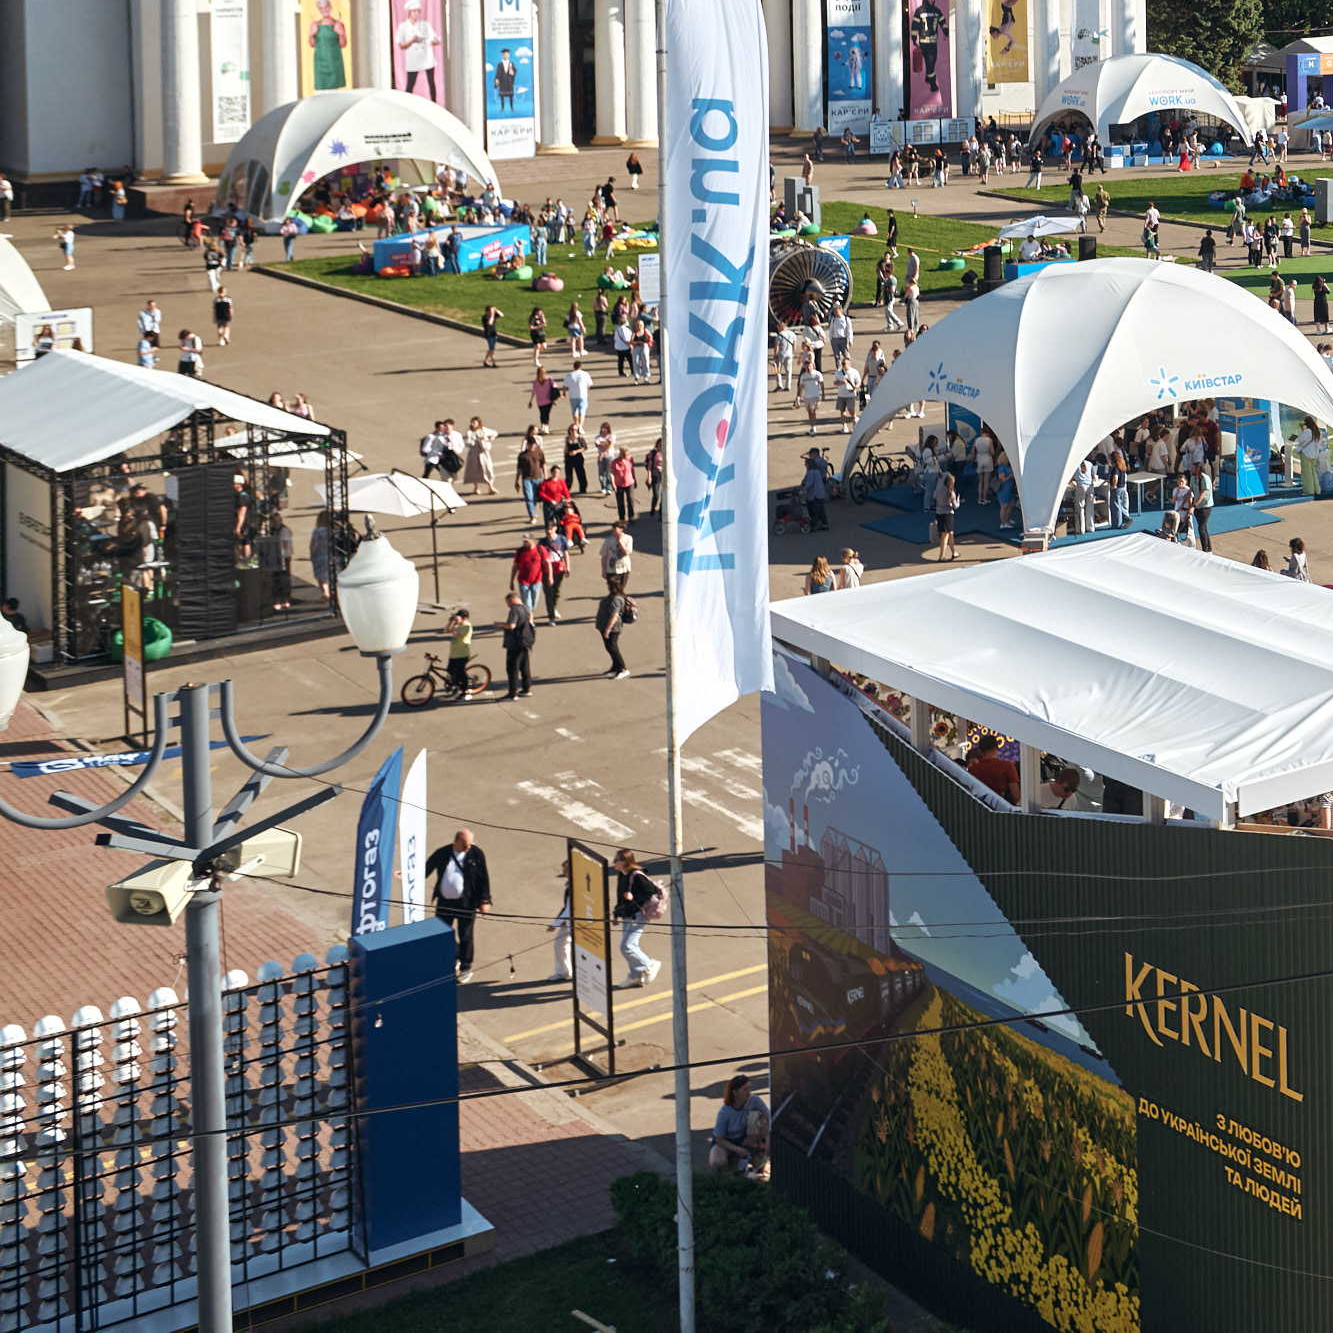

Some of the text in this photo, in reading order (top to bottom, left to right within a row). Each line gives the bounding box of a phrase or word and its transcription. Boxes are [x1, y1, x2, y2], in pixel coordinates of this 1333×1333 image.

[1148, 95, 1196, 106] WORK.ua
[945, 378, 981, 399] КИЇВСТАР
[1184, 372, 1243, 391] КИЇВСТАР
[357, 828, 381, 935] фтогаз
[407, 834, 417, 924] тогаз
[1125, 952, 1304, 1102] KERNEL
[1138, 1097, 1301, 1195] ДО УКРАЇНСЬКОЇ ЗЕМЛІ
[1216, 1113, 1301, 1168] З ЛЮБОВ'Ю
[1225, 1166, 1302, 1220] ТА ЛЮДЕЙ
